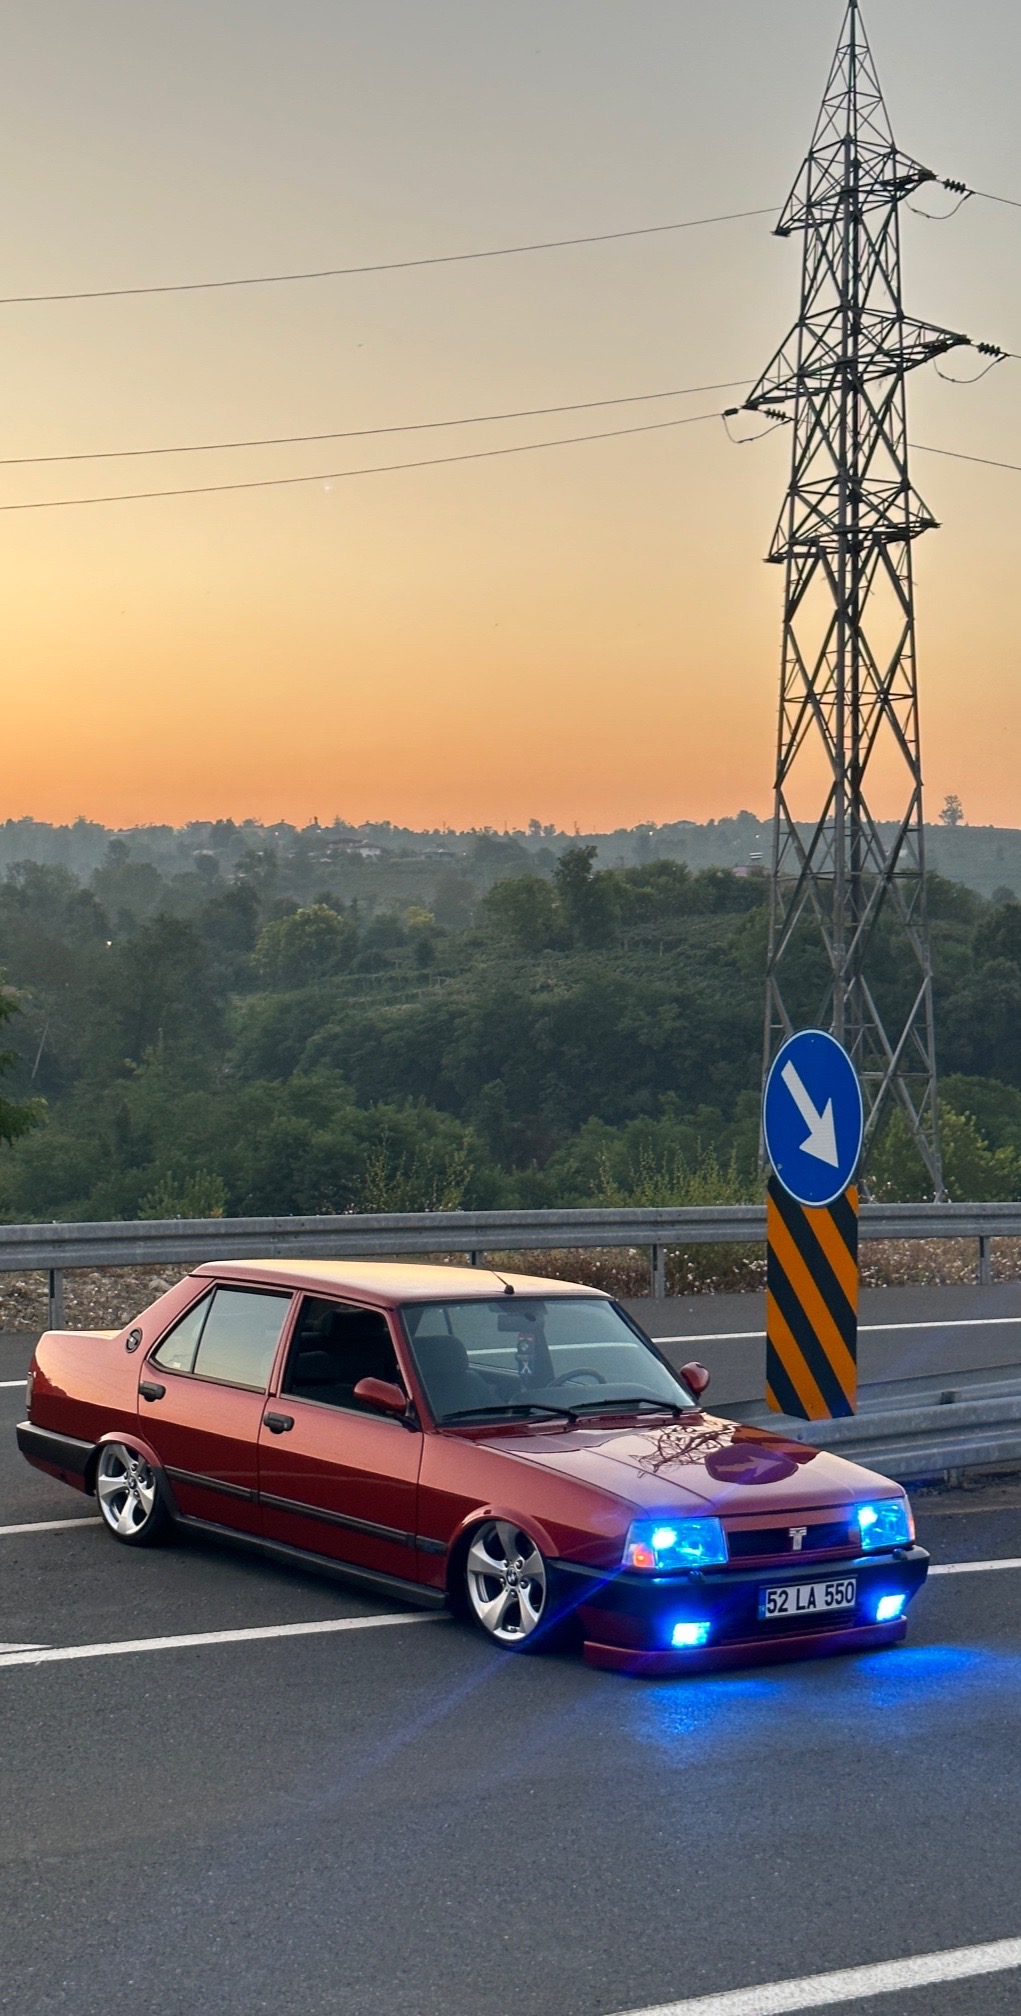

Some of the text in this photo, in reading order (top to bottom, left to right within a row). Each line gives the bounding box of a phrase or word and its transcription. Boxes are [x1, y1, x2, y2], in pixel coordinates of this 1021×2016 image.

[767, 1581, 855, 1614] 52 LA 550
